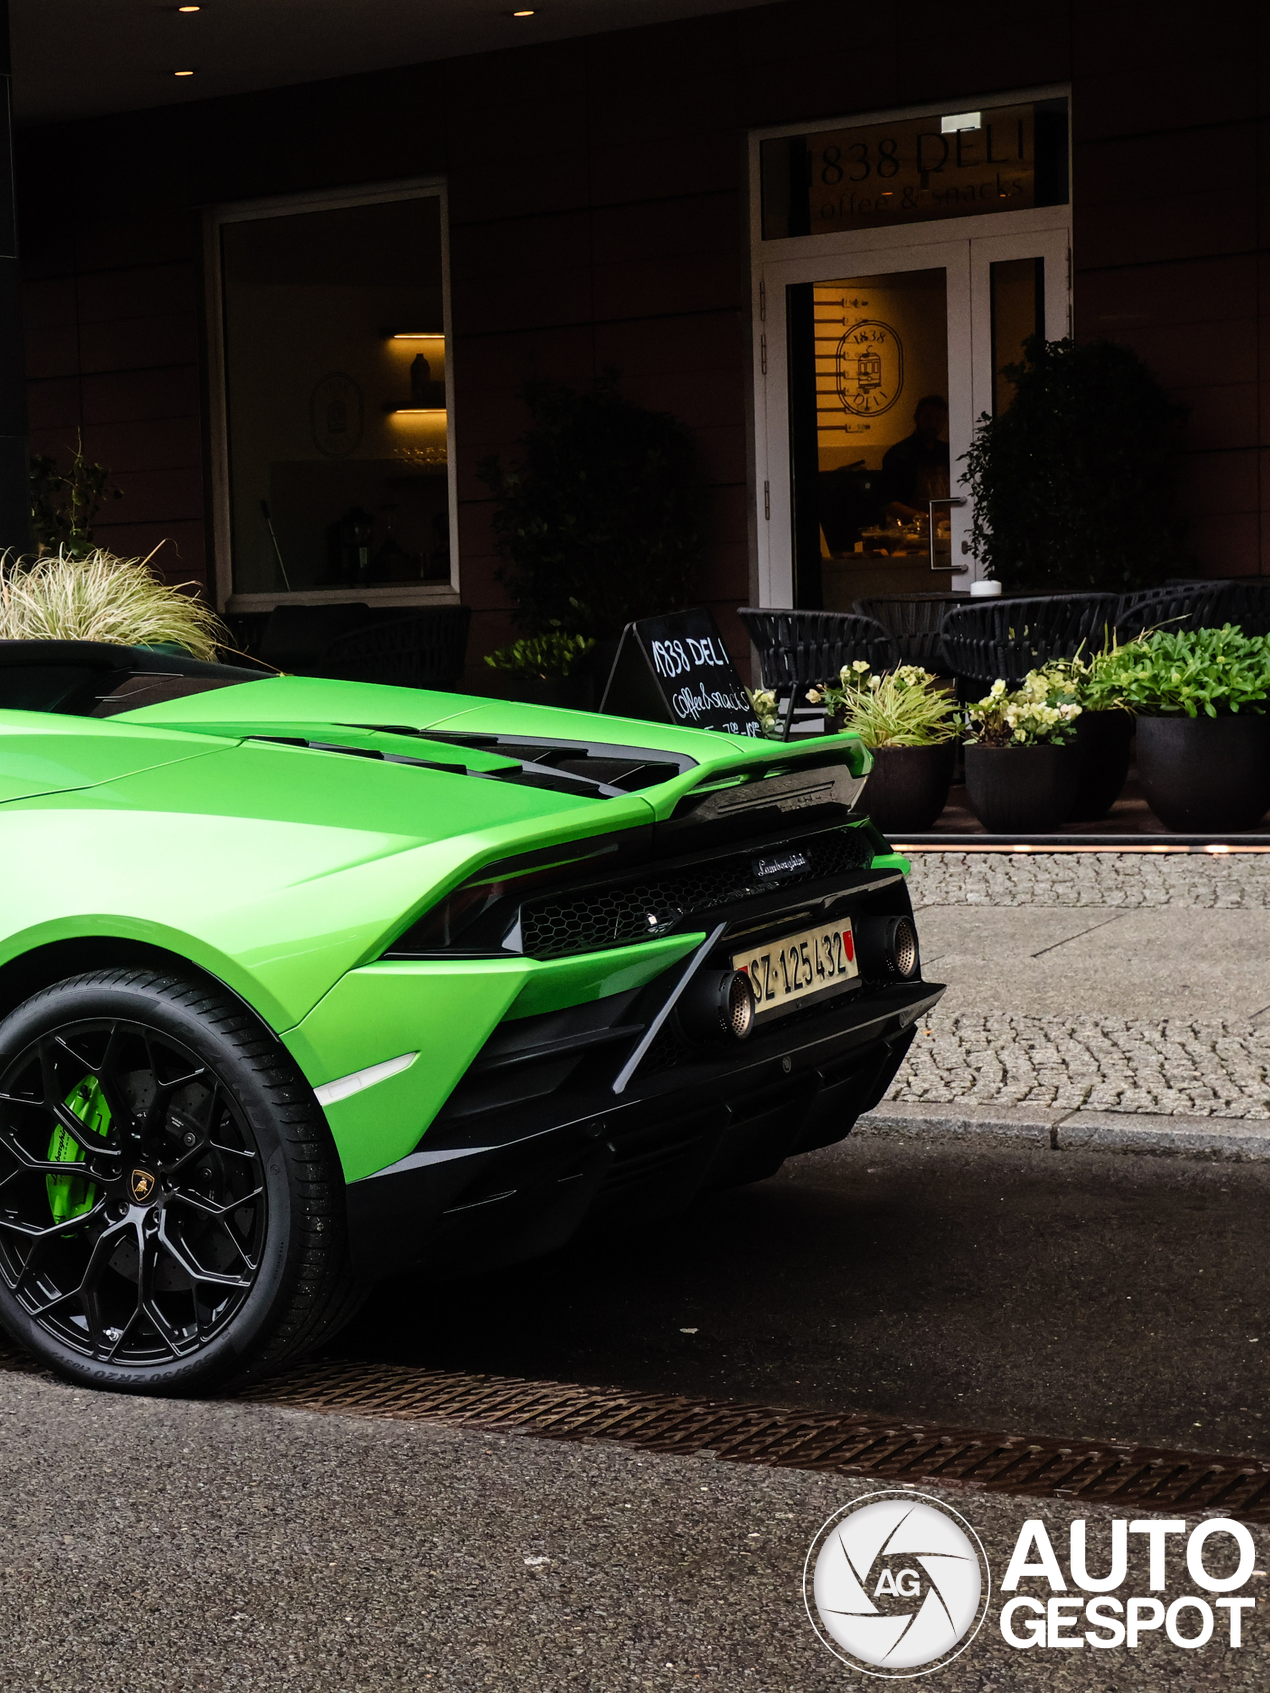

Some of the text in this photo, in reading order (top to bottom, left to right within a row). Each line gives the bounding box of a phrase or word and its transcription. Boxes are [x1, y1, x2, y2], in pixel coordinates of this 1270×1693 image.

[916, 118, 1025, 174] DELI
[820, 173, 1024, 221] offee & snacks
[853, 329, 886, 345] 1838
[651, 636, 730, 678] 1838 DELI
[757, 852, 806, 876] Lamborghini
